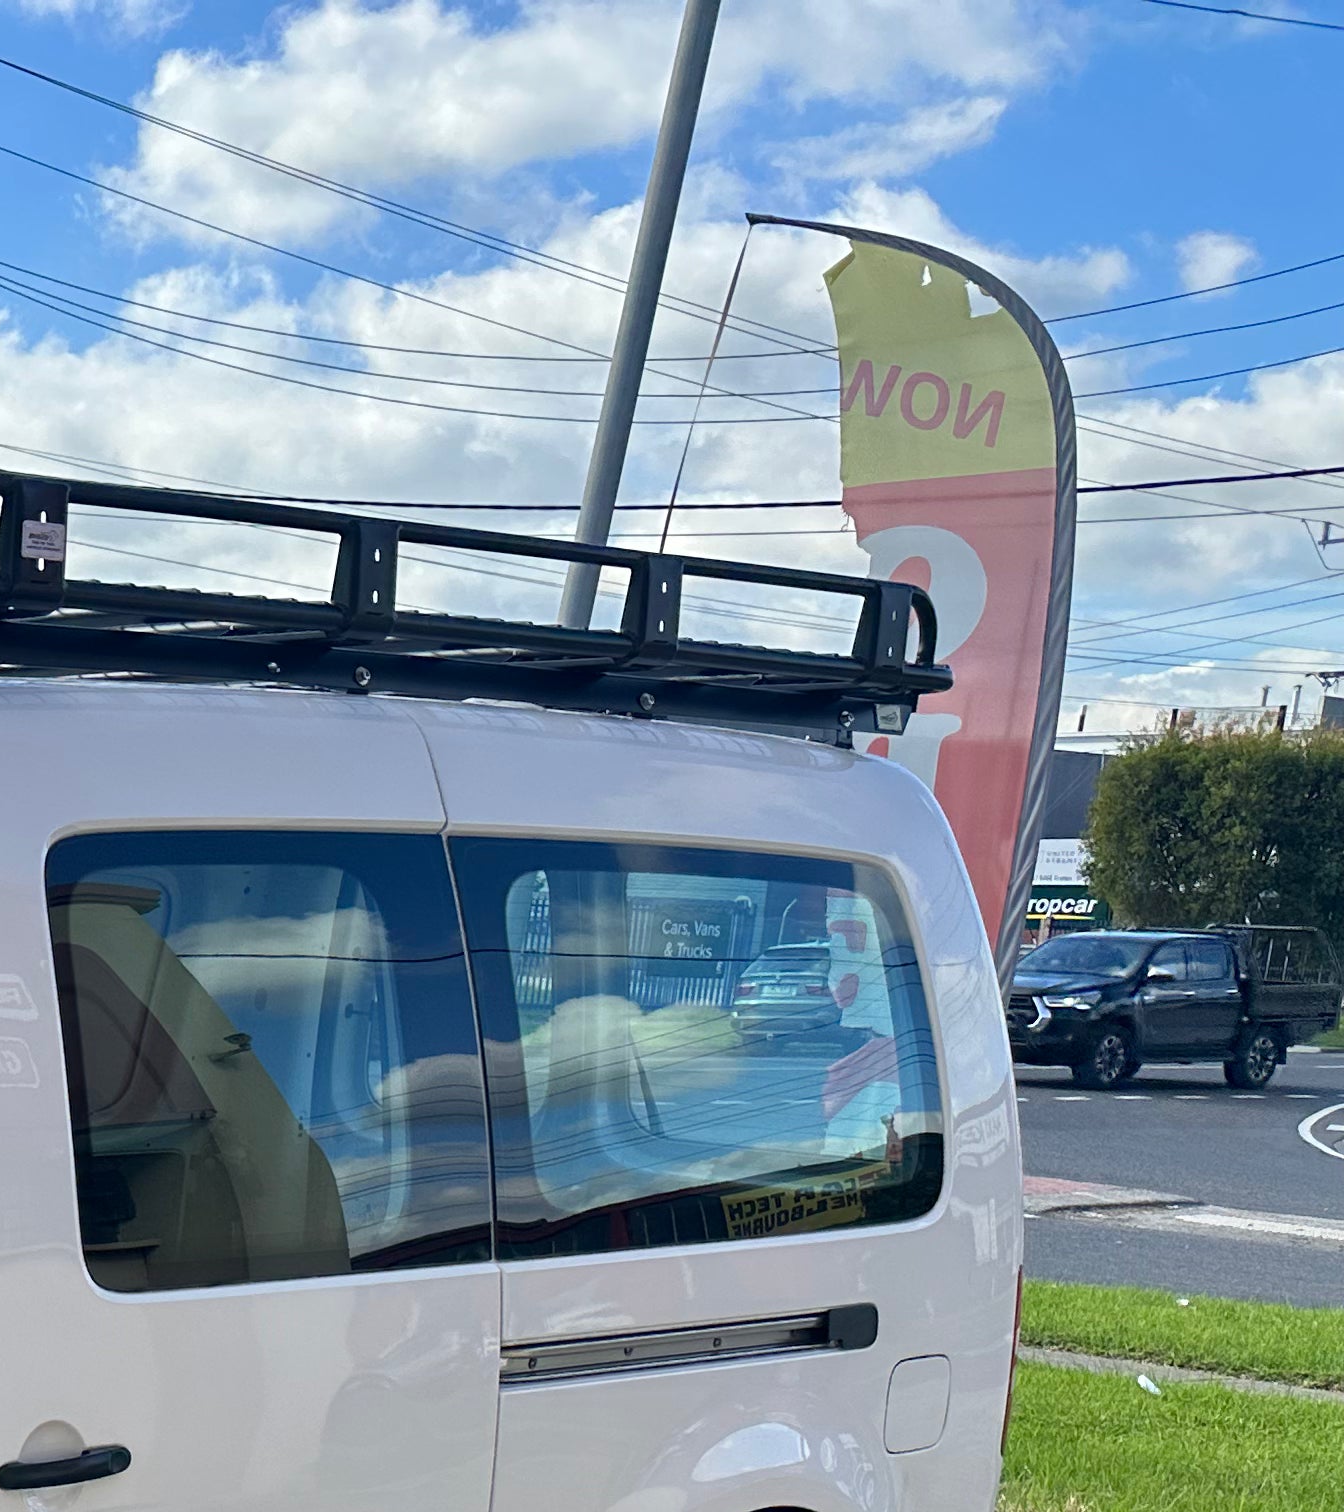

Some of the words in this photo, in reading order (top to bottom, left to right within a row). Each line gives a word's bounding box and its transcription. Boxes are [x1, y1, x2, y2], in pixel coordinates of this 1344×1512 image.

[662, 919, 691, 937] Cars,
[694, 920, 721, 937] Vans
[663, 941, 673, 957] &
[677, 942, 713, 958] Trucks
